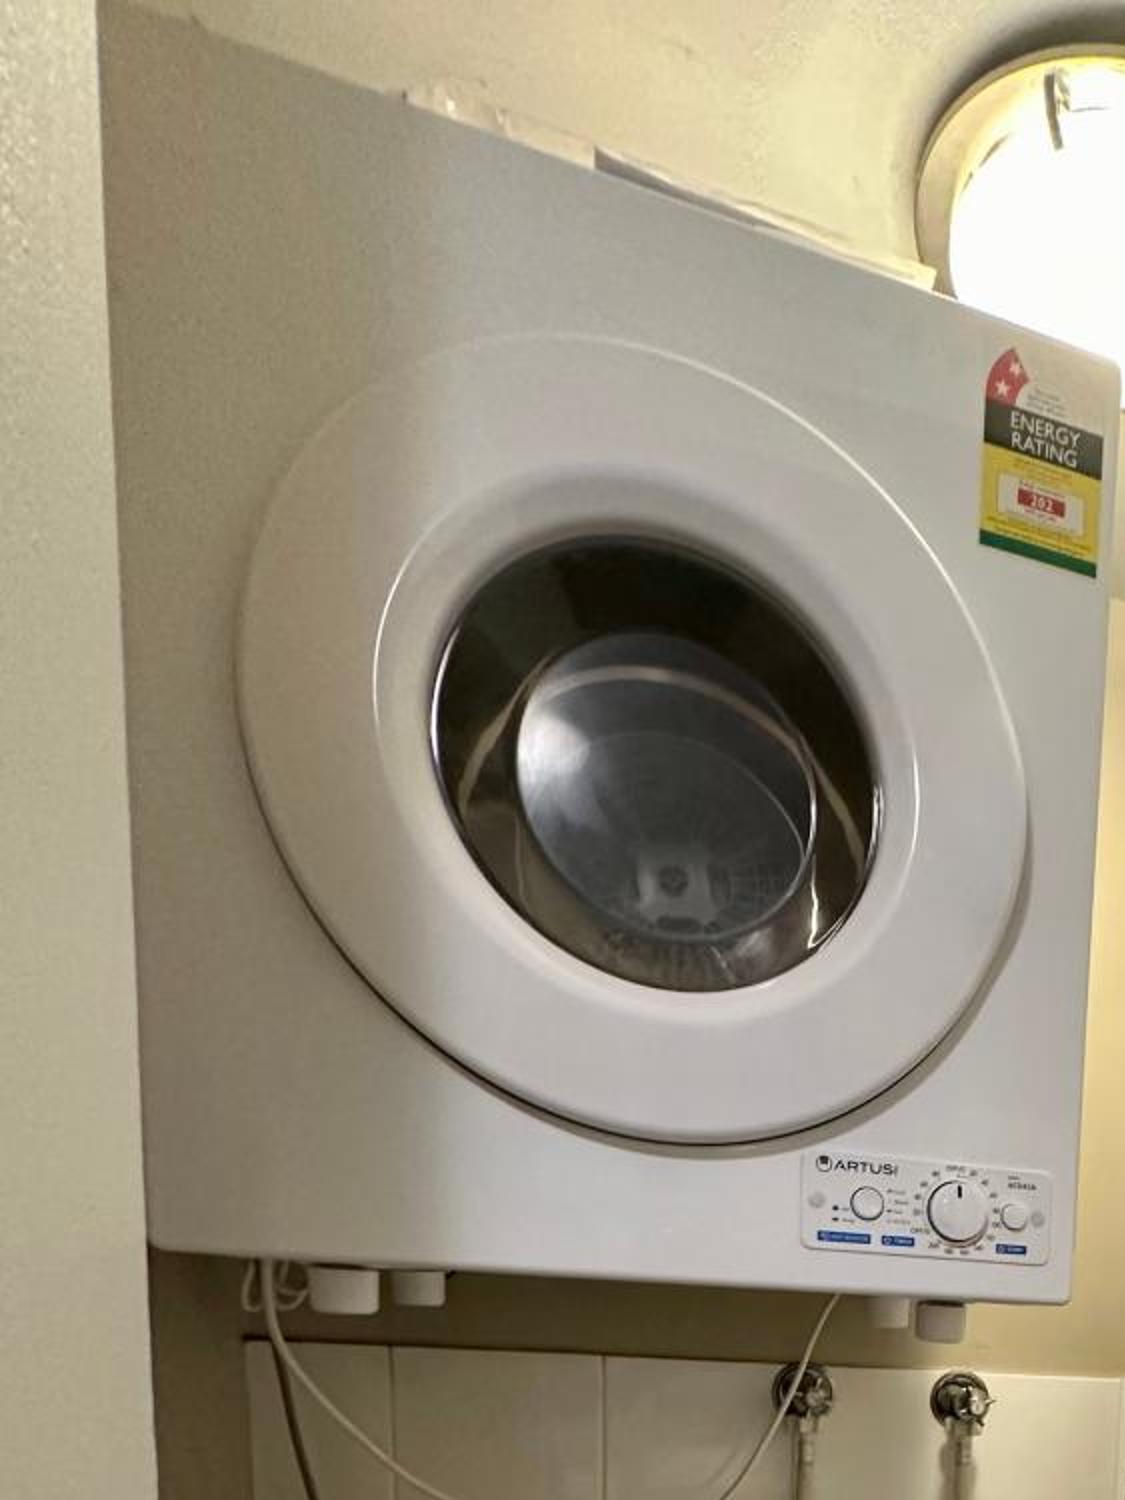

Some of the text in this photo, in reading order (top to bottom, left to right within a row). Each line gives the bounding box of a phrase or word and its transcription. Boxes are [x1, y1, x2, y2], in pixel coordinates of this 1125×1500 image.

[1010, 410, 1081, 448] ENERGY
[1011, 431, 1078, 469] RATING
[834, 1159, 898, 1177] ARTUSI
